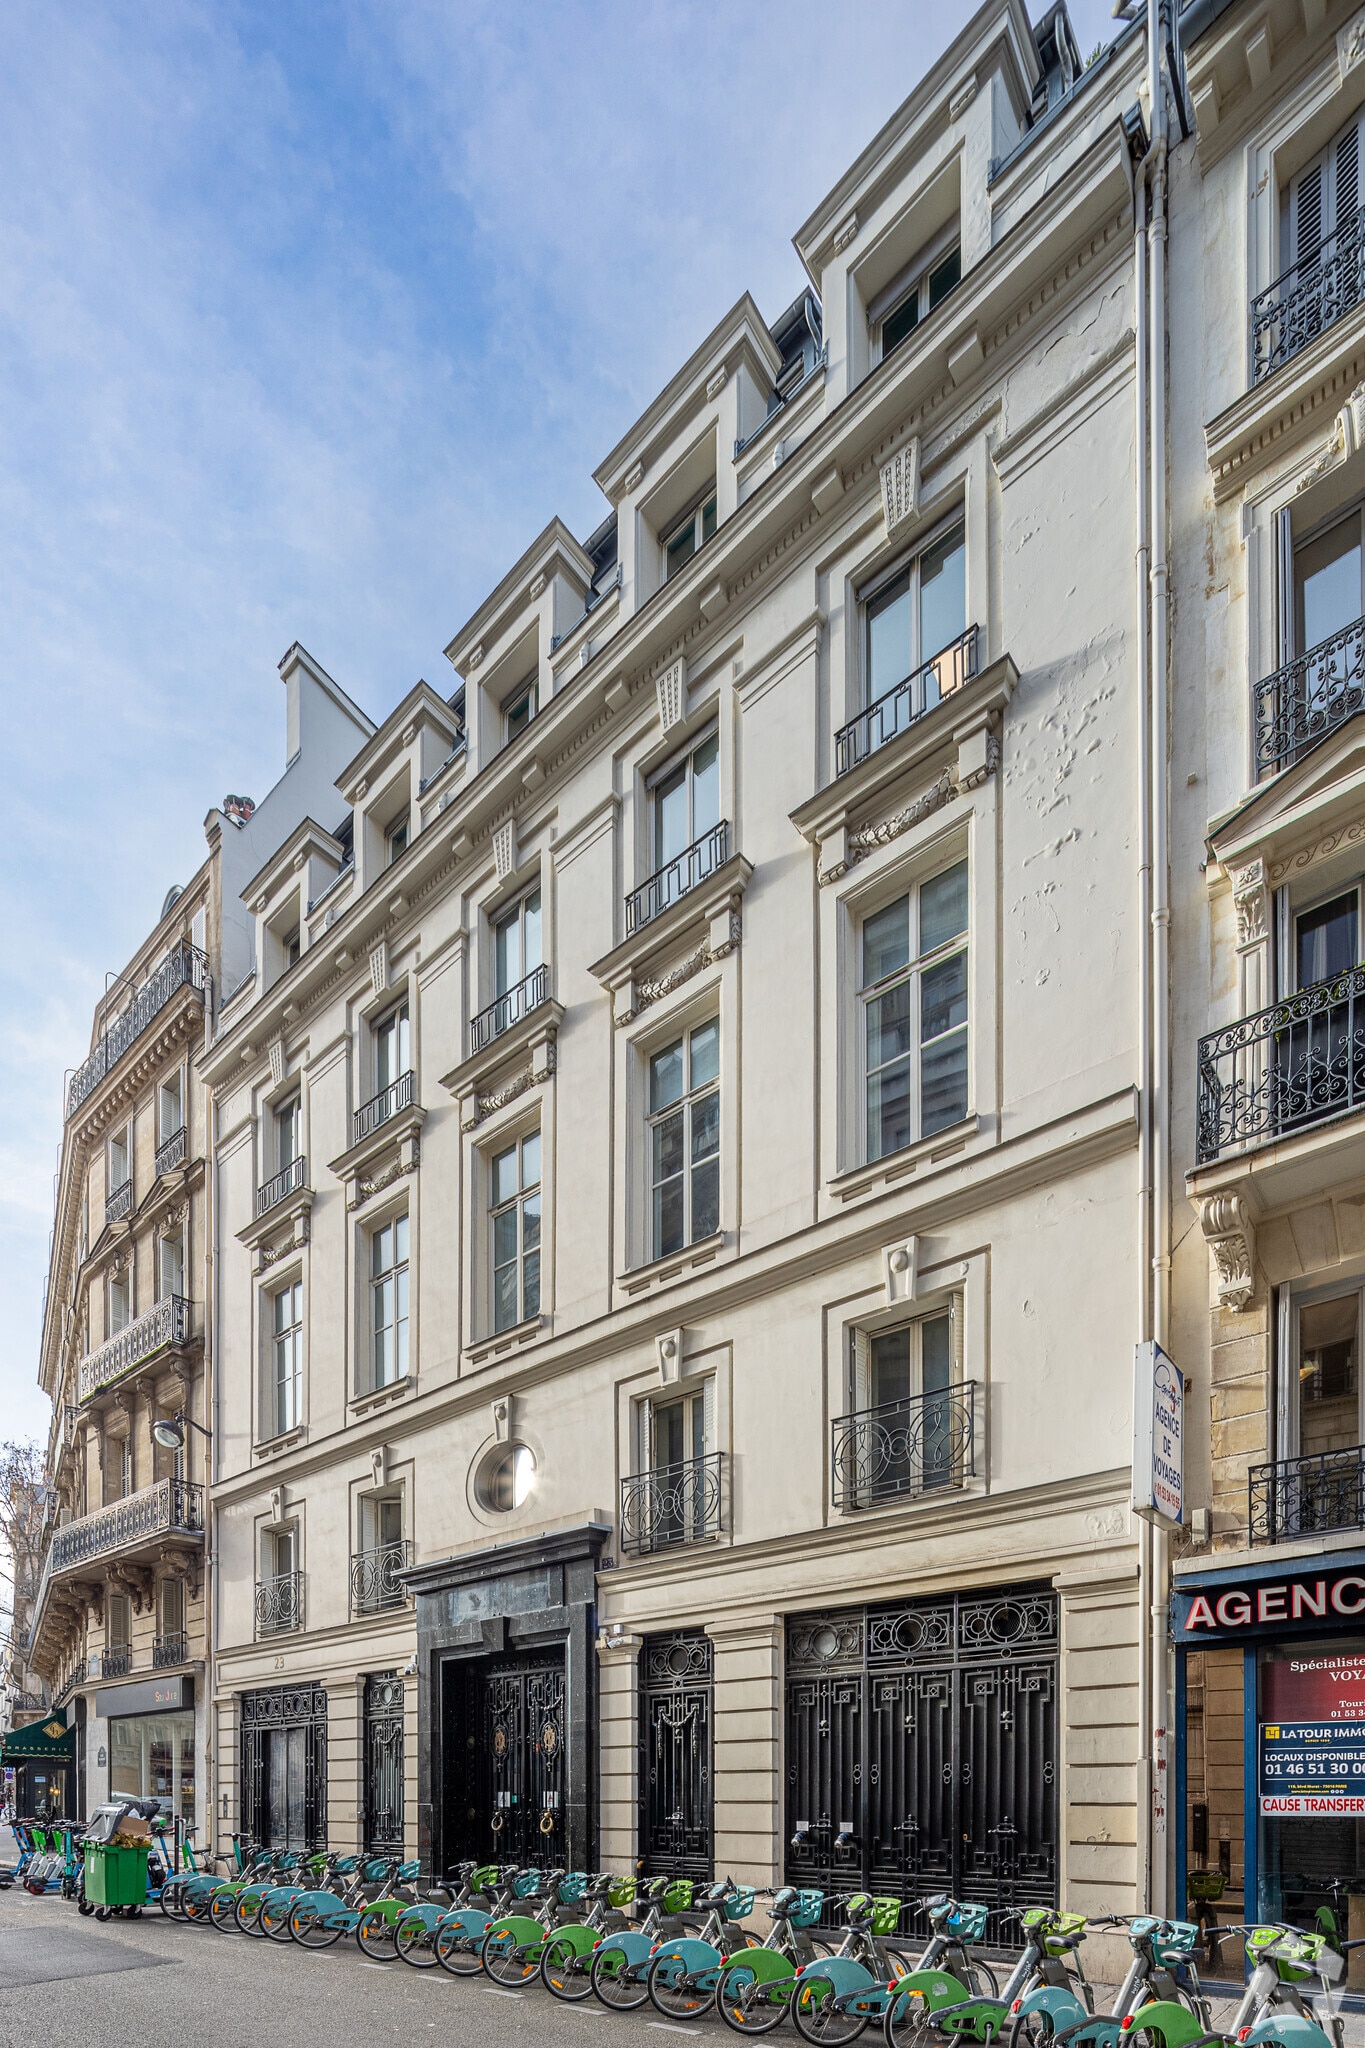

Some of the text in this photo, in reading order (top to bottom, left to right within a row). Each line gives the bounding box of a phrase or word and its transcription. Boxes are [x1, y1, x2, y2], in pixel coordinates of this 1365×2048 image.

[1155, 1402, 1180, 1438] AGENCE
[1163, 1435, 1172, 1458] DE
[1153, 1453, 1181, 1490] VOYAGES
[1184, 1577, 1365, 1630] AGENC
[274, 1656, 285, 1669] 23
[1290, 1657, 1365, 1673] Spécialiste
[1338, 1699, 1365, 1708] Tour
[1331, 1708, 1365, 1718] 01 53 3
[1282, 1729, 1297, 1739] LA
[1297, 1728, 1332, 1739] TOUR
[1265, 1752, 1365, 1762] LOCAUX DISPONIBLE
[1265, 1763, 1283, 1775] 01
[1286, 1763, 1304, 1775] 46
[1308, 1763, 1326, 1775] 51
[1330, 1762, 1348, 1774] 30
[1263, 1798, 1365, 1811] CAUSE TRANSFER
